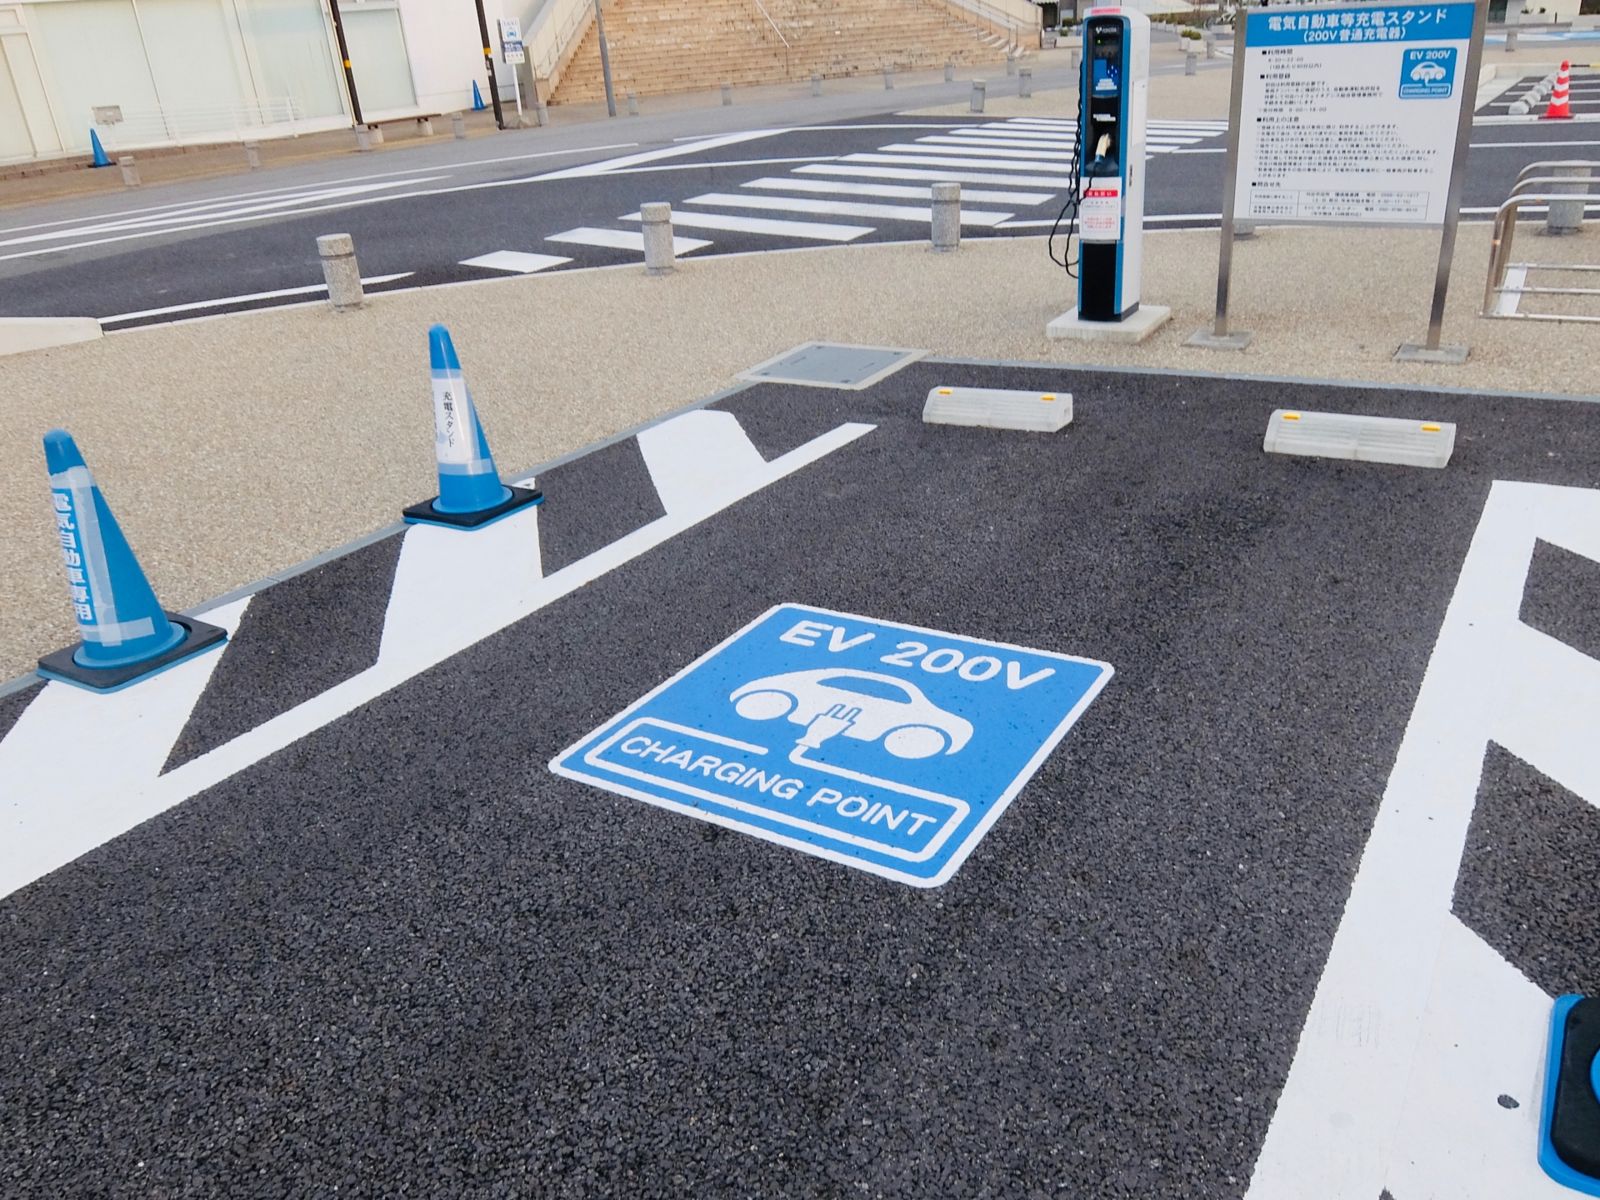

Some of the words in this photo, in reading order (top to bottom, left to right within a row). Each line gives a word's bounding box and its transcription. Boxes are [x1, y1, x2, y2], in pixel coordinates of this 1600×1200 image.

[1268, 9, 1446, 31] 電気自動車等充電スタンド
[1410, 51, 1424, 60] EV
[1425, 50, 1450, 60] 200V
[443, 391, 455, 448] 充電スタンド
[779, 620, 875, 653] EV
[880, 640, 1055, 691] 200V
[620, 735, 804, 801] CHARGING
[808, 786, 937, 837] POINT
